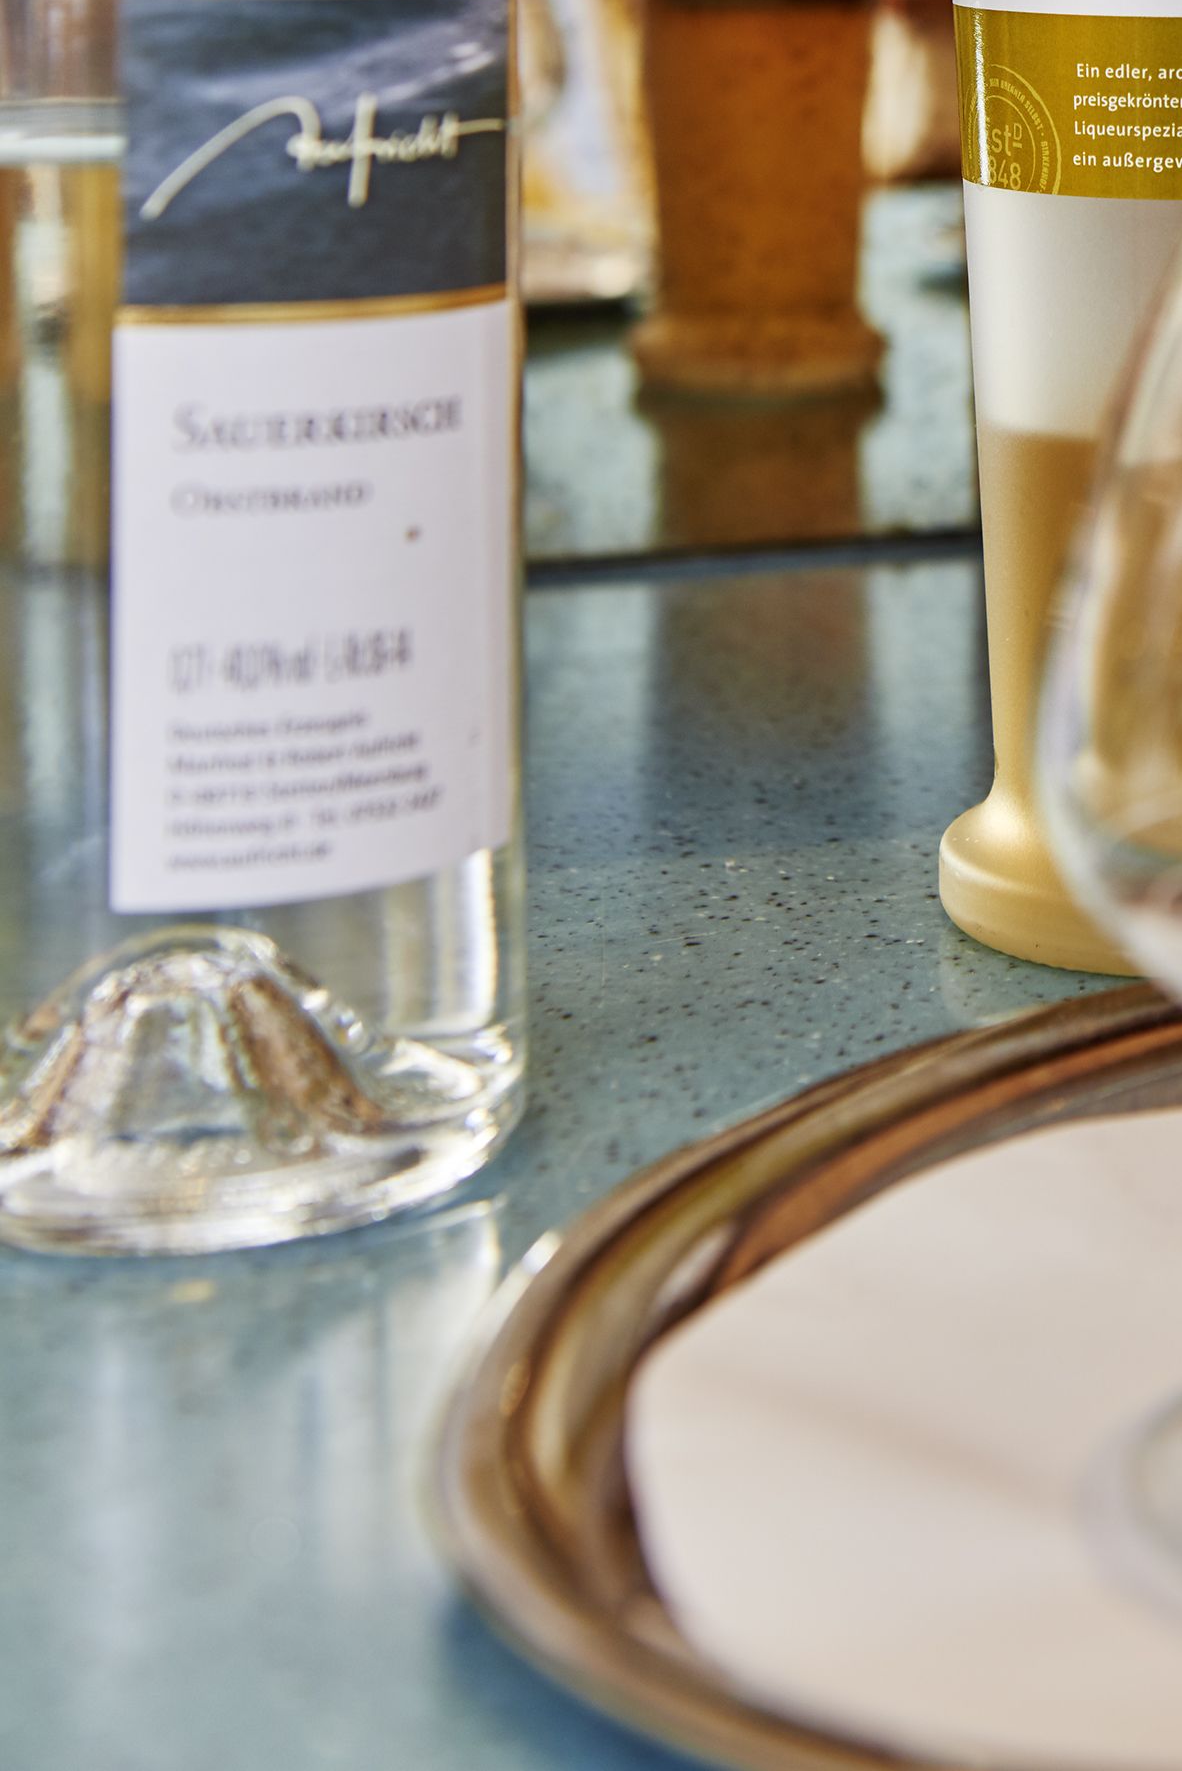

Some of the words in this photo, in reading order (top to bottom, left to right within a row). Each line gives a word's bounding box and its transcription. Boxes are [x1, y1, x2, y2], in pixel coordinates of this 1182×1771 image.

[1076, 63, 1100, 78] Ein
[1105, 63, 1152, 81] edler,
[1073, 152, 1097, 166] ein
